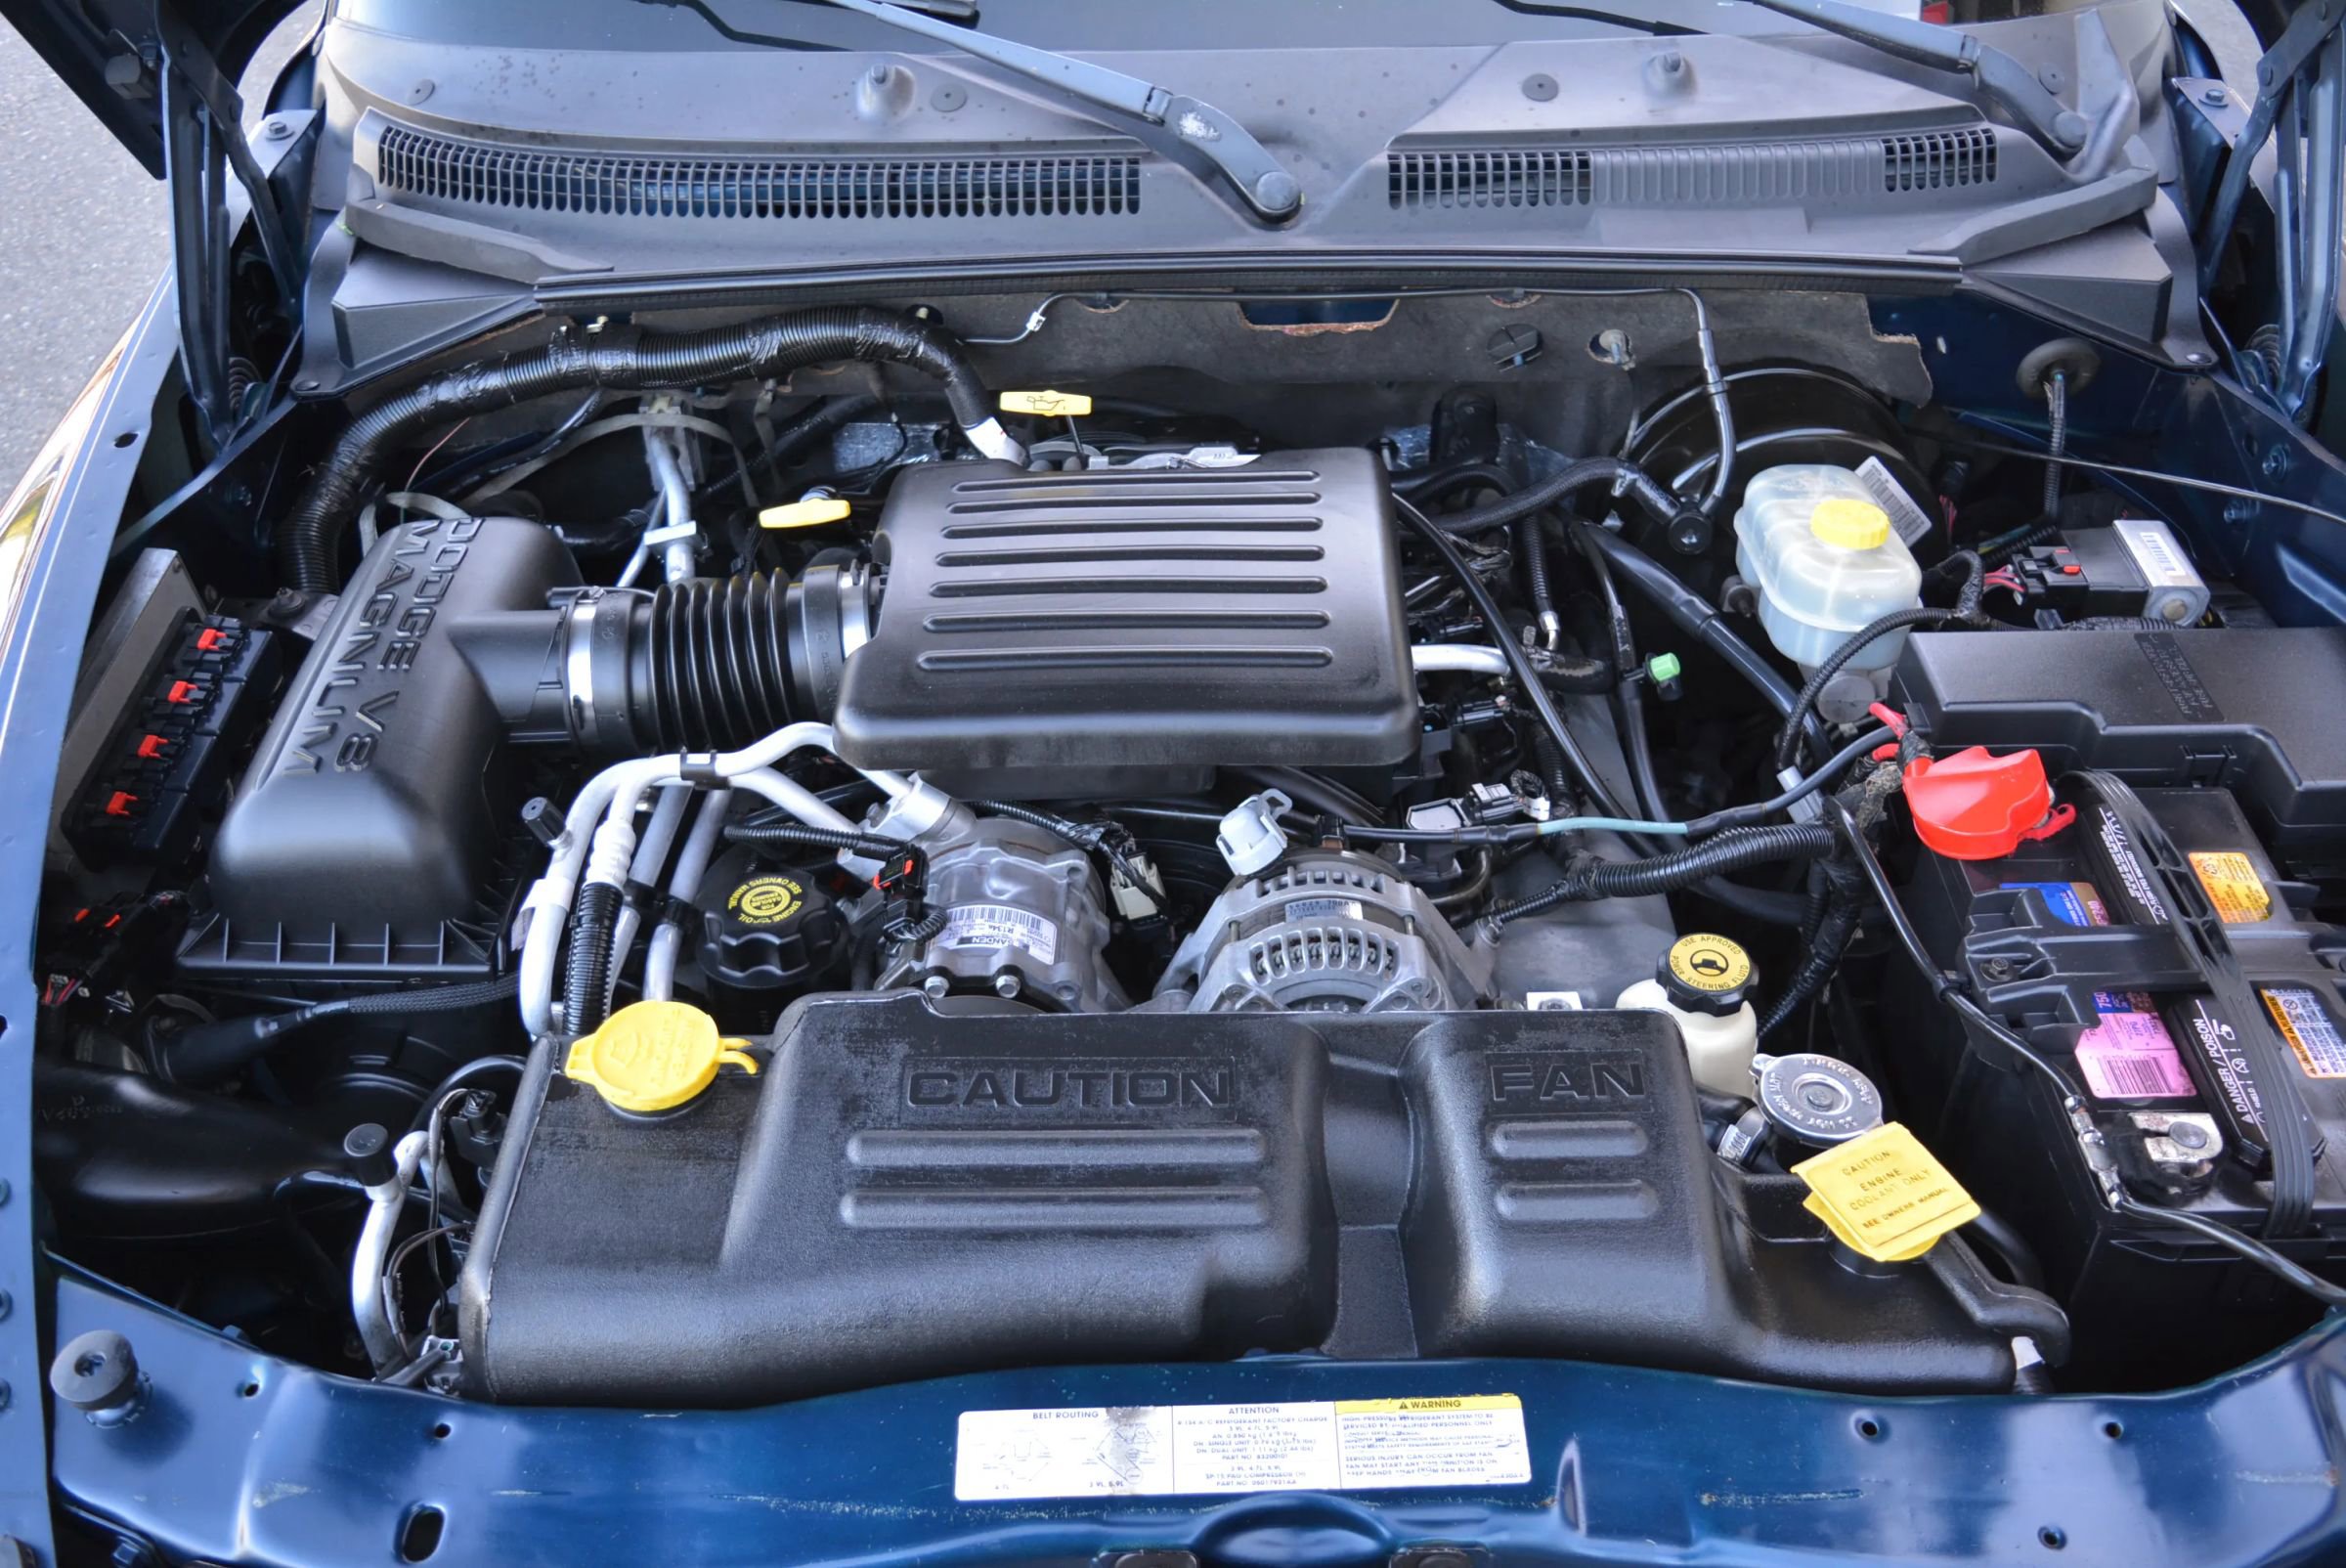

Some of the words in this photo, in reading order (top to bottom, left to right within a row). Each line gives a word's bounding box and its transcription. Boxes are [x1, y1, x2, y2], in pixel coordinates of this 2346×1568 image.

[377, 517, 484, 672] DODGE
[283, 519, 442, 775] MAGNUM
[334, 689, 399, 773] V8
[750, 878, 789, 887] OWNERS
[788, 882, 802, 894] SEE
[738, 914, 753, 923] OIL
[772, 900, 802, 922] ENGINE
[1680, 937, 1696, 947] USE
[1701, 936, 1741, 955] APPROVED
[1672, 955, 1684, 976] POWER
[1686, 978, 1730, 989] STEERING
[1732, 965, 1748, 983] FLUID
[2094, 991, 2112, 1009] 750
[2193, 1019, 2221, 1058] POISON
[908, 1070, 1229, 1109] CAUTION
[1490, 1063, 1645, 1103] FAN
[2217, 1067, 2249, 1111] DANGER
[1842, 1151, 1890, 1177] CAUTION
[1850, 1183, 1901, 1211] COOLANT
[1903, 1168, 1931, 1189] ONLY
[1859, 1168, 1901, 1192] ENGINE
[1862, 1215, 1881, 1228] SEE
[1918, 1186, 1949, 1204] MANUAL
[1228, 1406, 1280, 1415] ATTENTION
[1411, 1400, 1461, 1409] WARNING
